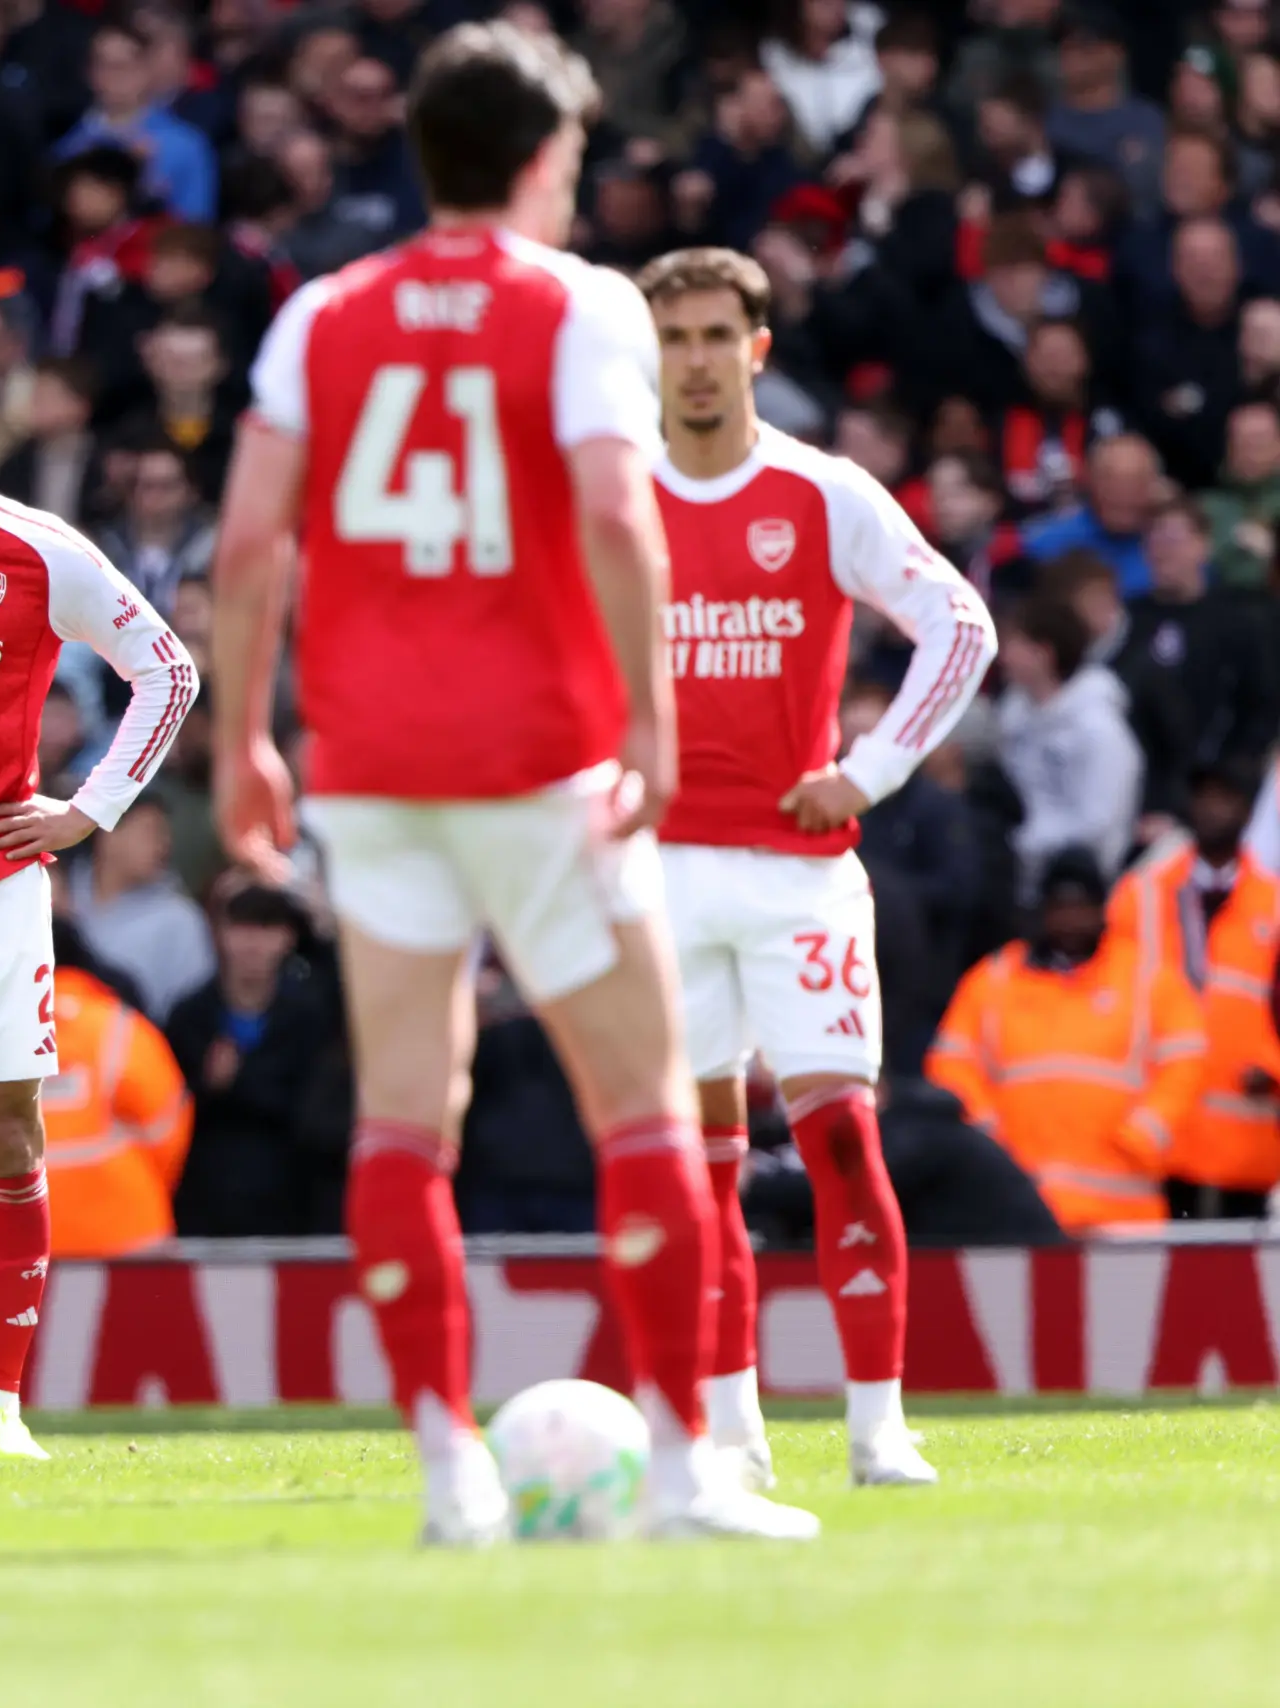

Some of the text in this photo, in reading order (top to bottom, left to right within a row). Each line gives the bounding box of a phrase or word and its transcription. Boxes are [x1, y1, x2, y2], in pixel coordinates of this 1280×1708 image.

[335, 365, 514, 577] 41
[658, 592, 806, 638] mirates
[694, 640, 783, 679] BETTER
[793, 931, 871, 1000] 36
